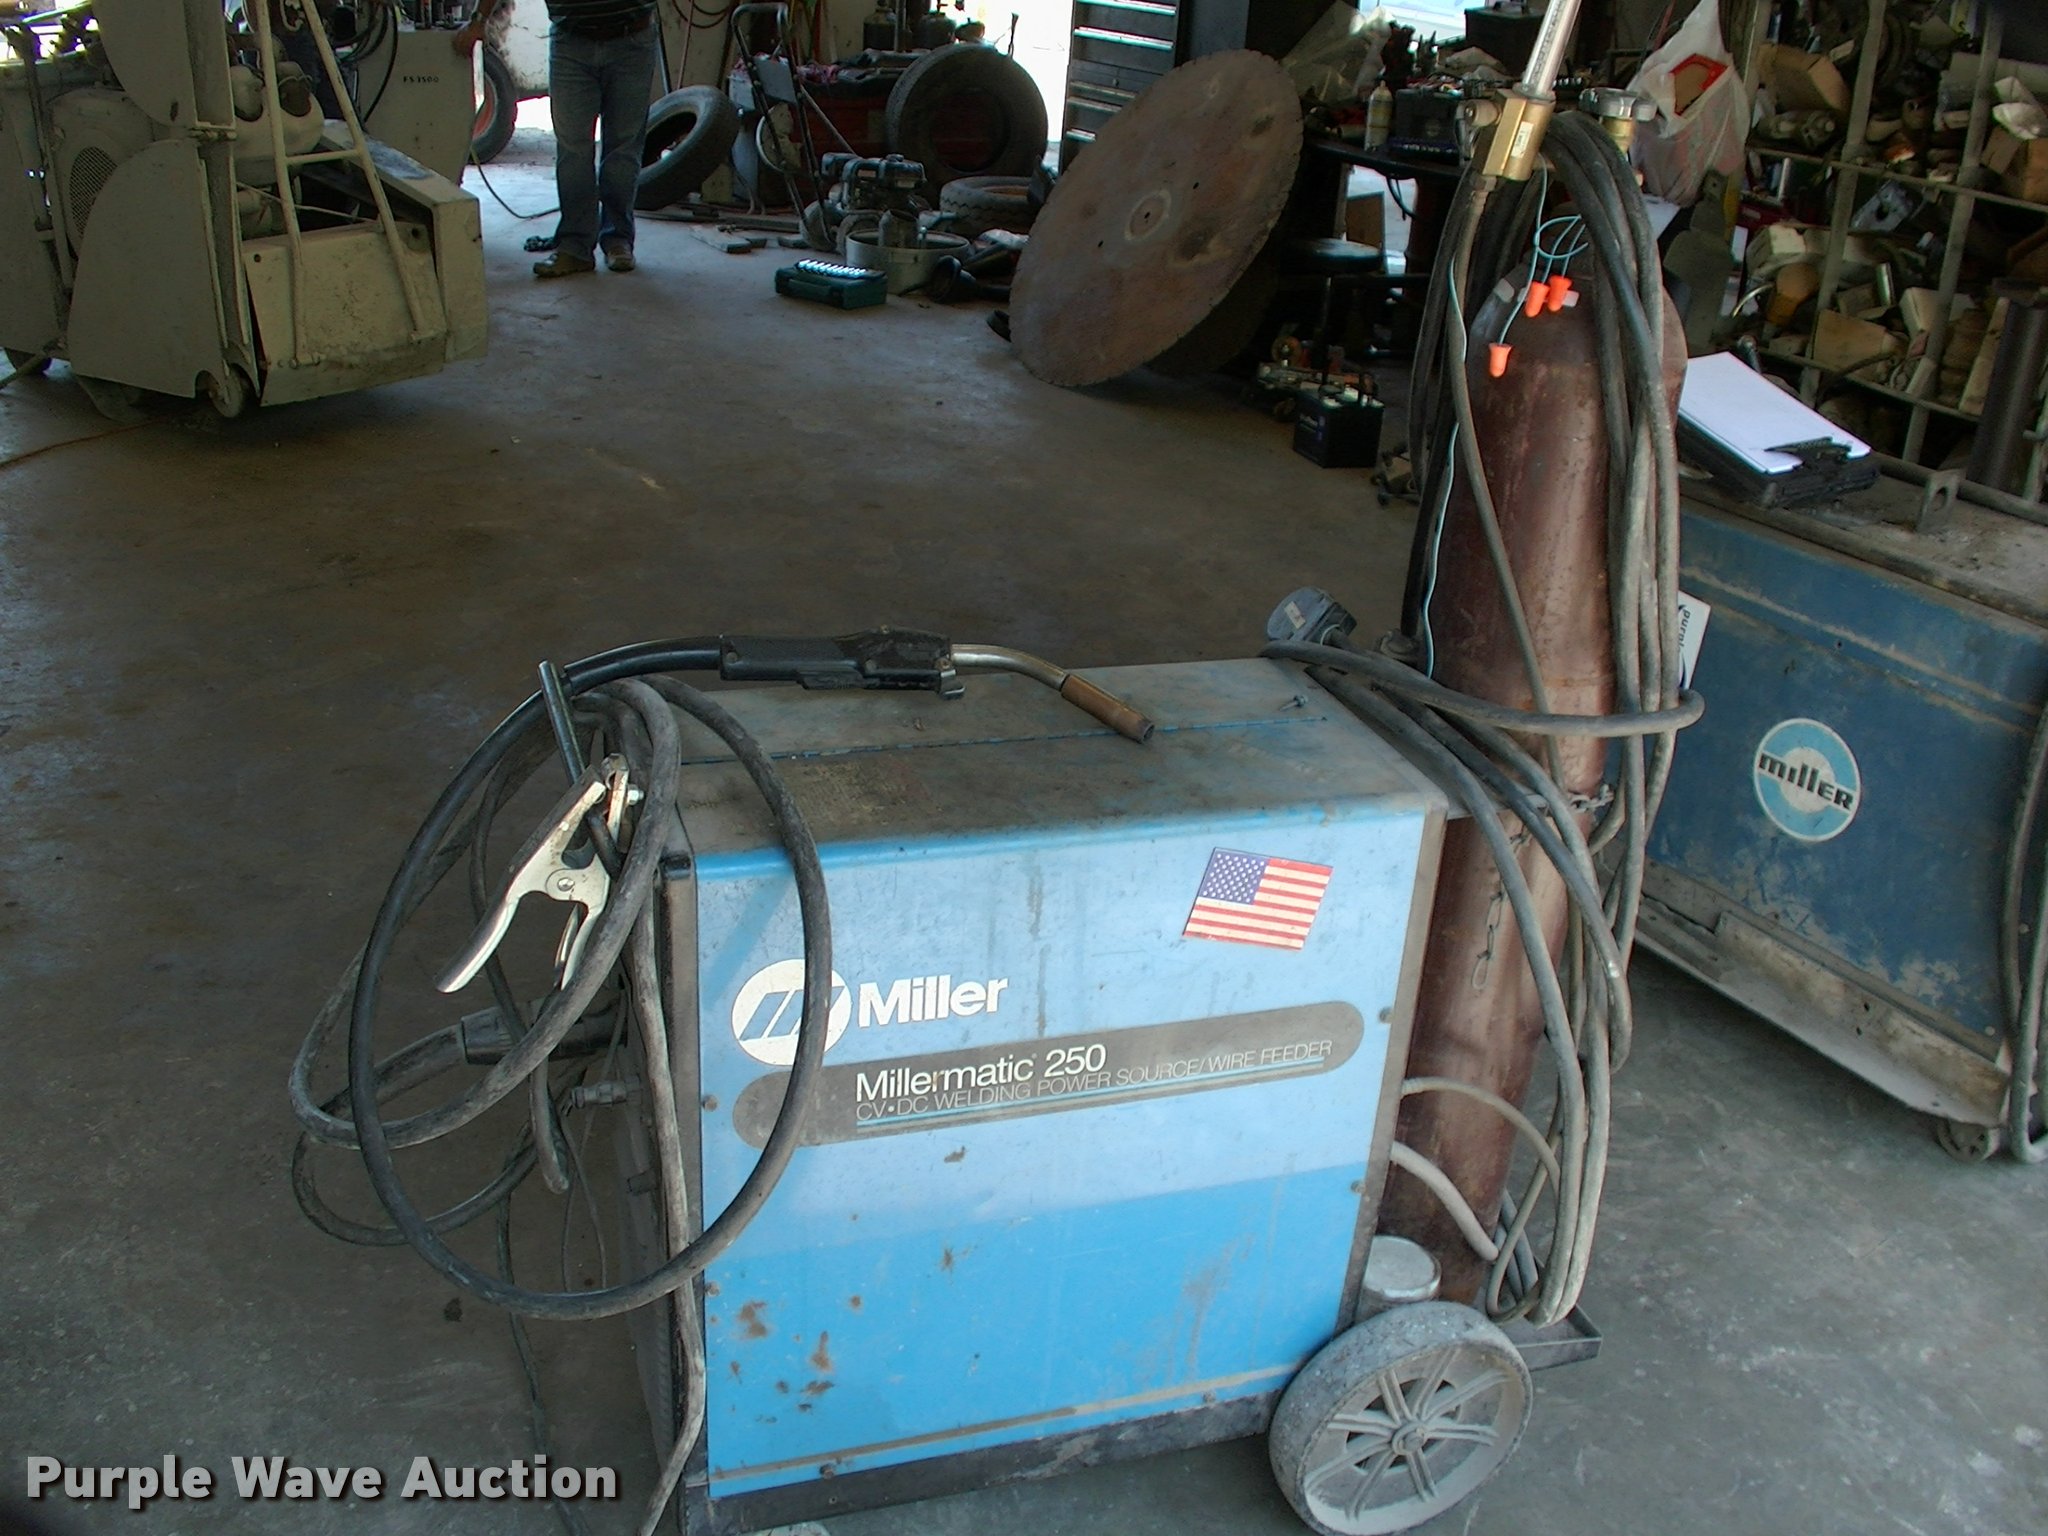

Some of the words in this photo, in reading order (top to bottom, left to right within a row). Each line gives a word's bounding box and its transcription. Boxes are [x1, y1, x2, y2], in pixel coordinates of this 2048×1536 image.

[858, 974, 1009, 1028] Miller
[856, 1054, 1034, 1103] Millermatic
[1044, 1044, 1107, 1078] 250
[934, 1082, 1032, 1111] WELDING
[1037, 1071, 1112, 1096] POWER
[1260, 1040, 1333, 1065] FEEDER
